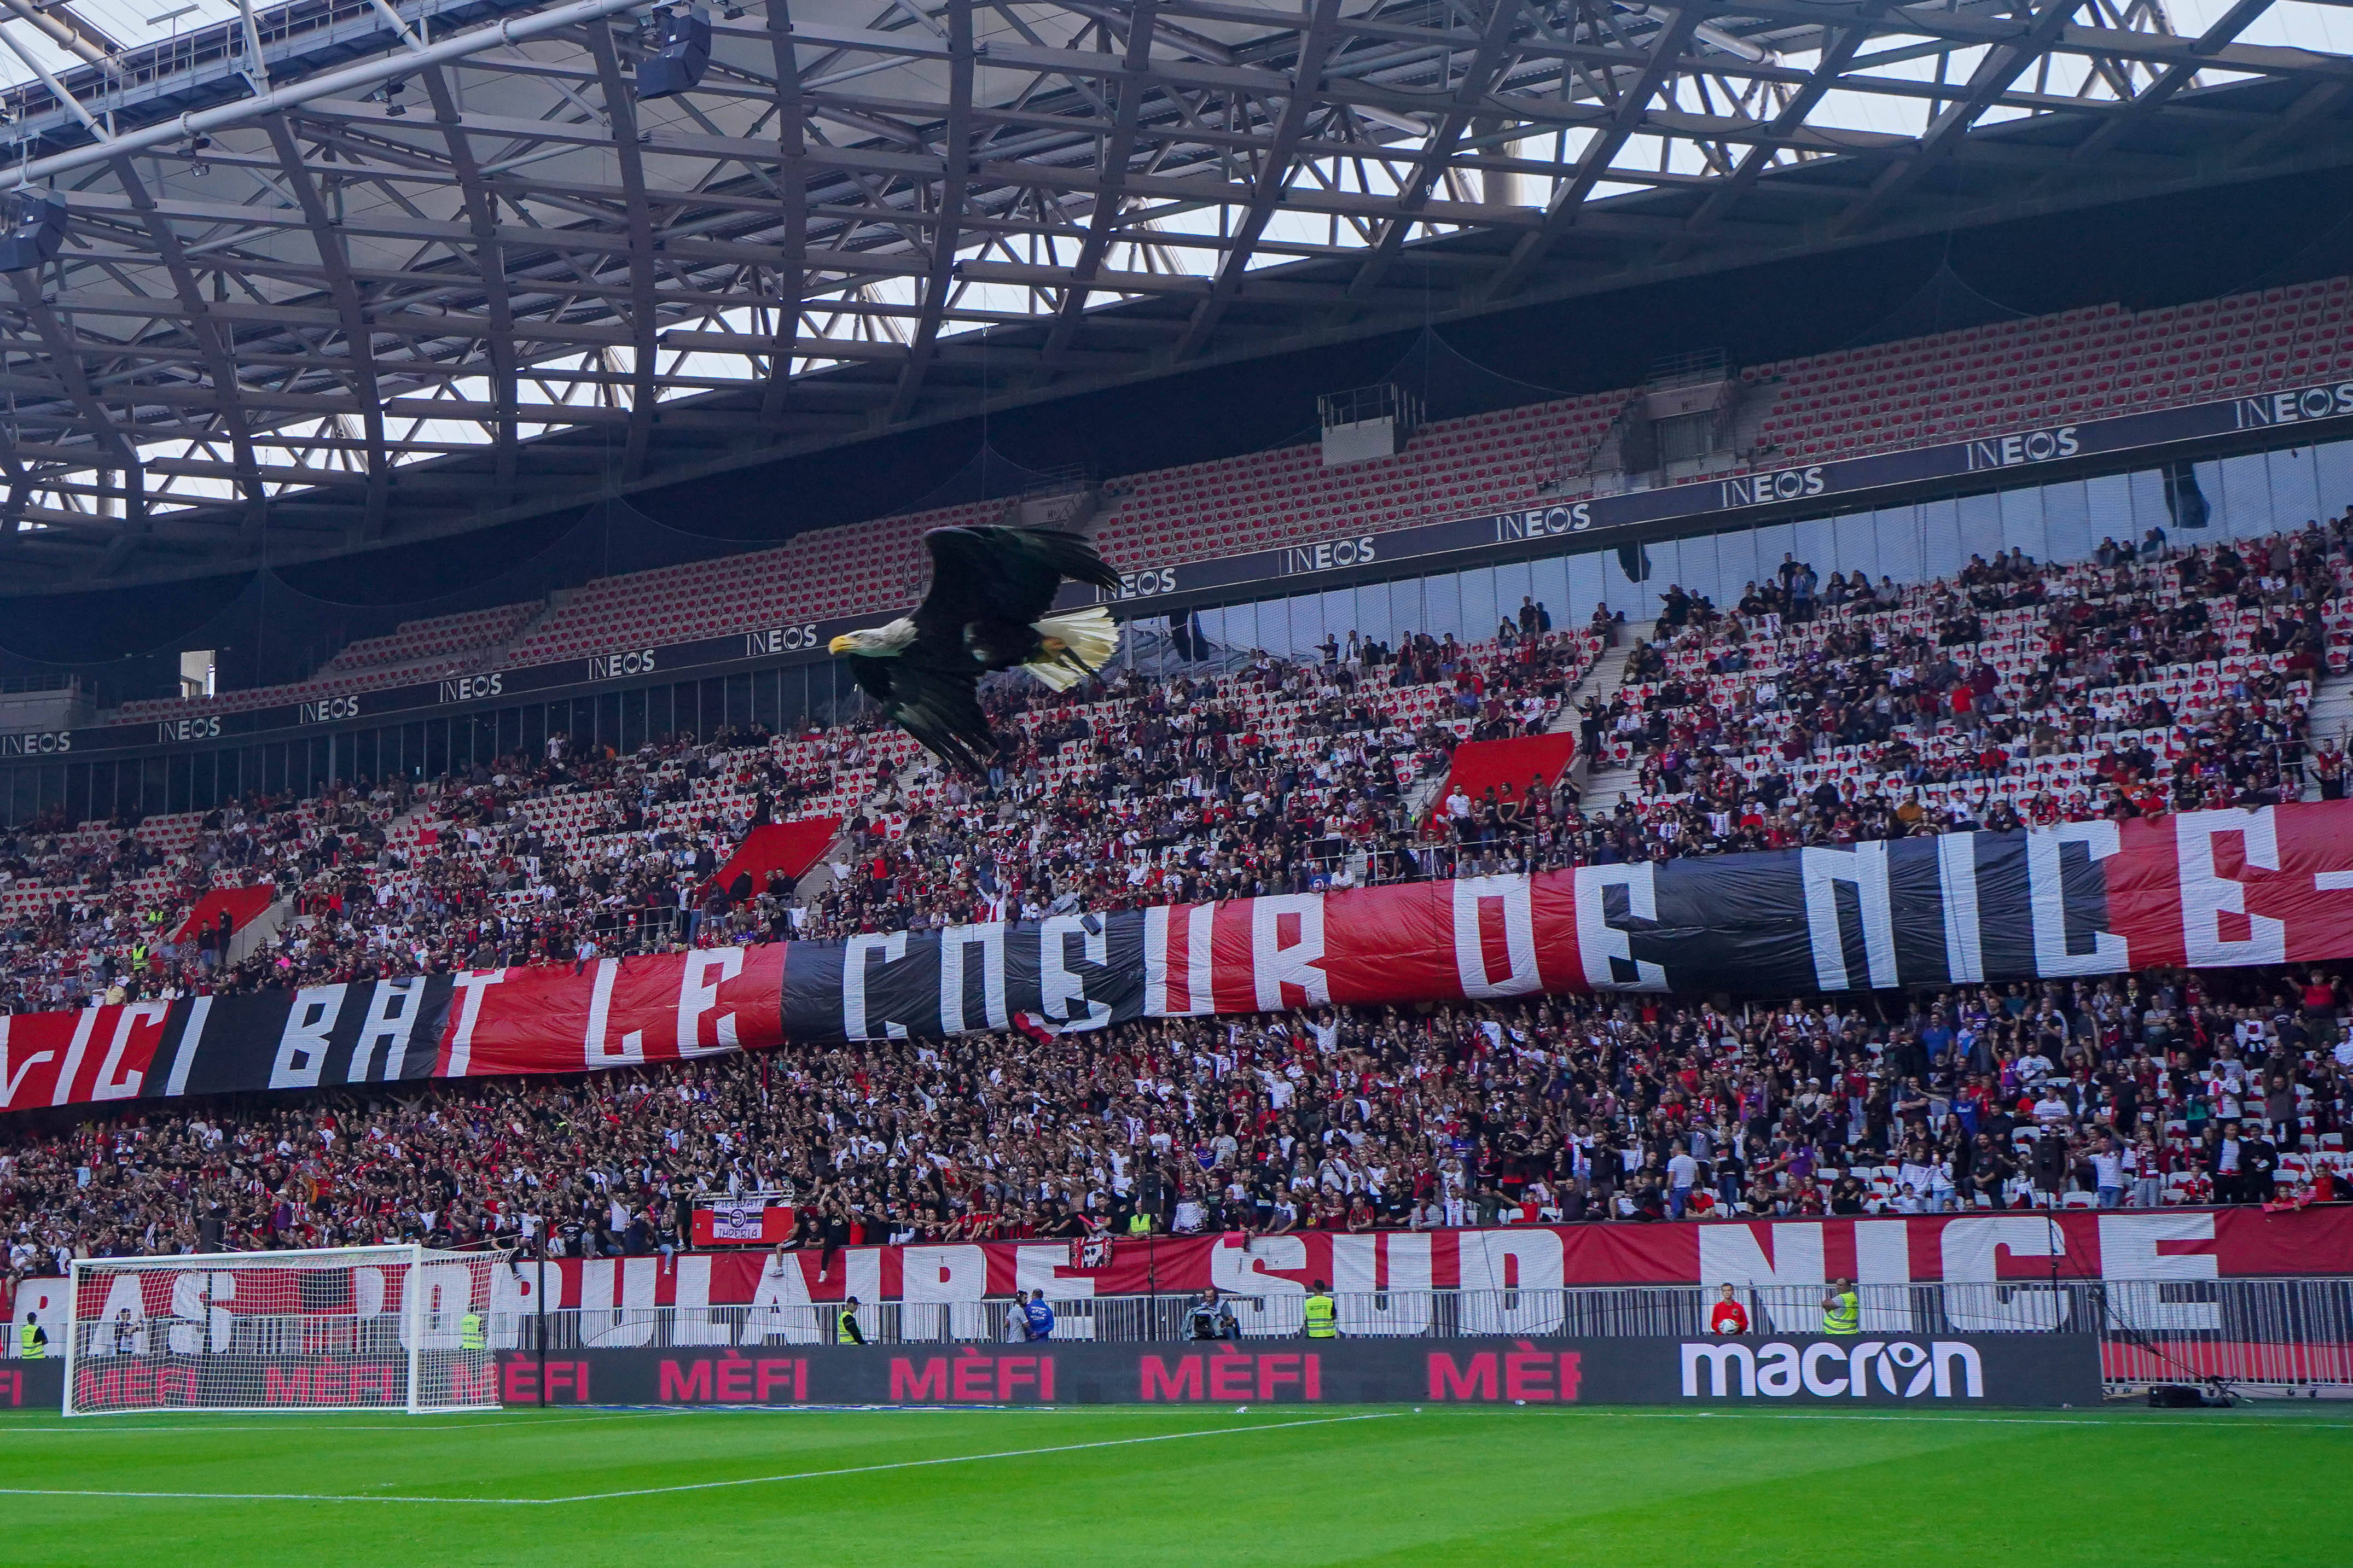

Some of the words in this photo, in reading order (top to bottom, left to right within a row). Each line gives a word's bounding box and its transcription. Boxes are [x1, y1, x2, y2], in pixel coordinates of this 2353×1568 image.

[1966, 427, 2078, 471] INEOS
[1722, 467, 1825, 509] INEOS
[1496, 503, 1590, 542] INEOS
[1287, 537, 1375, 574] INEOS
[746, 624, 817, 656] INEOS
[588, 649, 655, 680] INEOS
[439, 673, 503, 703] INEOS
[158, 716, 220, 743] INEOS
[299, 696, 359, 725] INEOS
[2, 731, 71, 756] INEOS
[269, 967, 507, 1089] BAT
[584, 946, 744, 1070] LE
[1453, 860, 1672, 999] DE
[718, 1228, 758, 1239] IMPERIA
[1211, 1228, 1565, 1335] SUD
[1699, 1213, 2221, 1332] NICE
[660, 1349, 807, 1401] MÈFI
[890, 1347, 1055, 1401] MÈFI
[1141, 1343, 1321, 1401] MÈFI
[1681, 1340, 1983, 1398] macron
